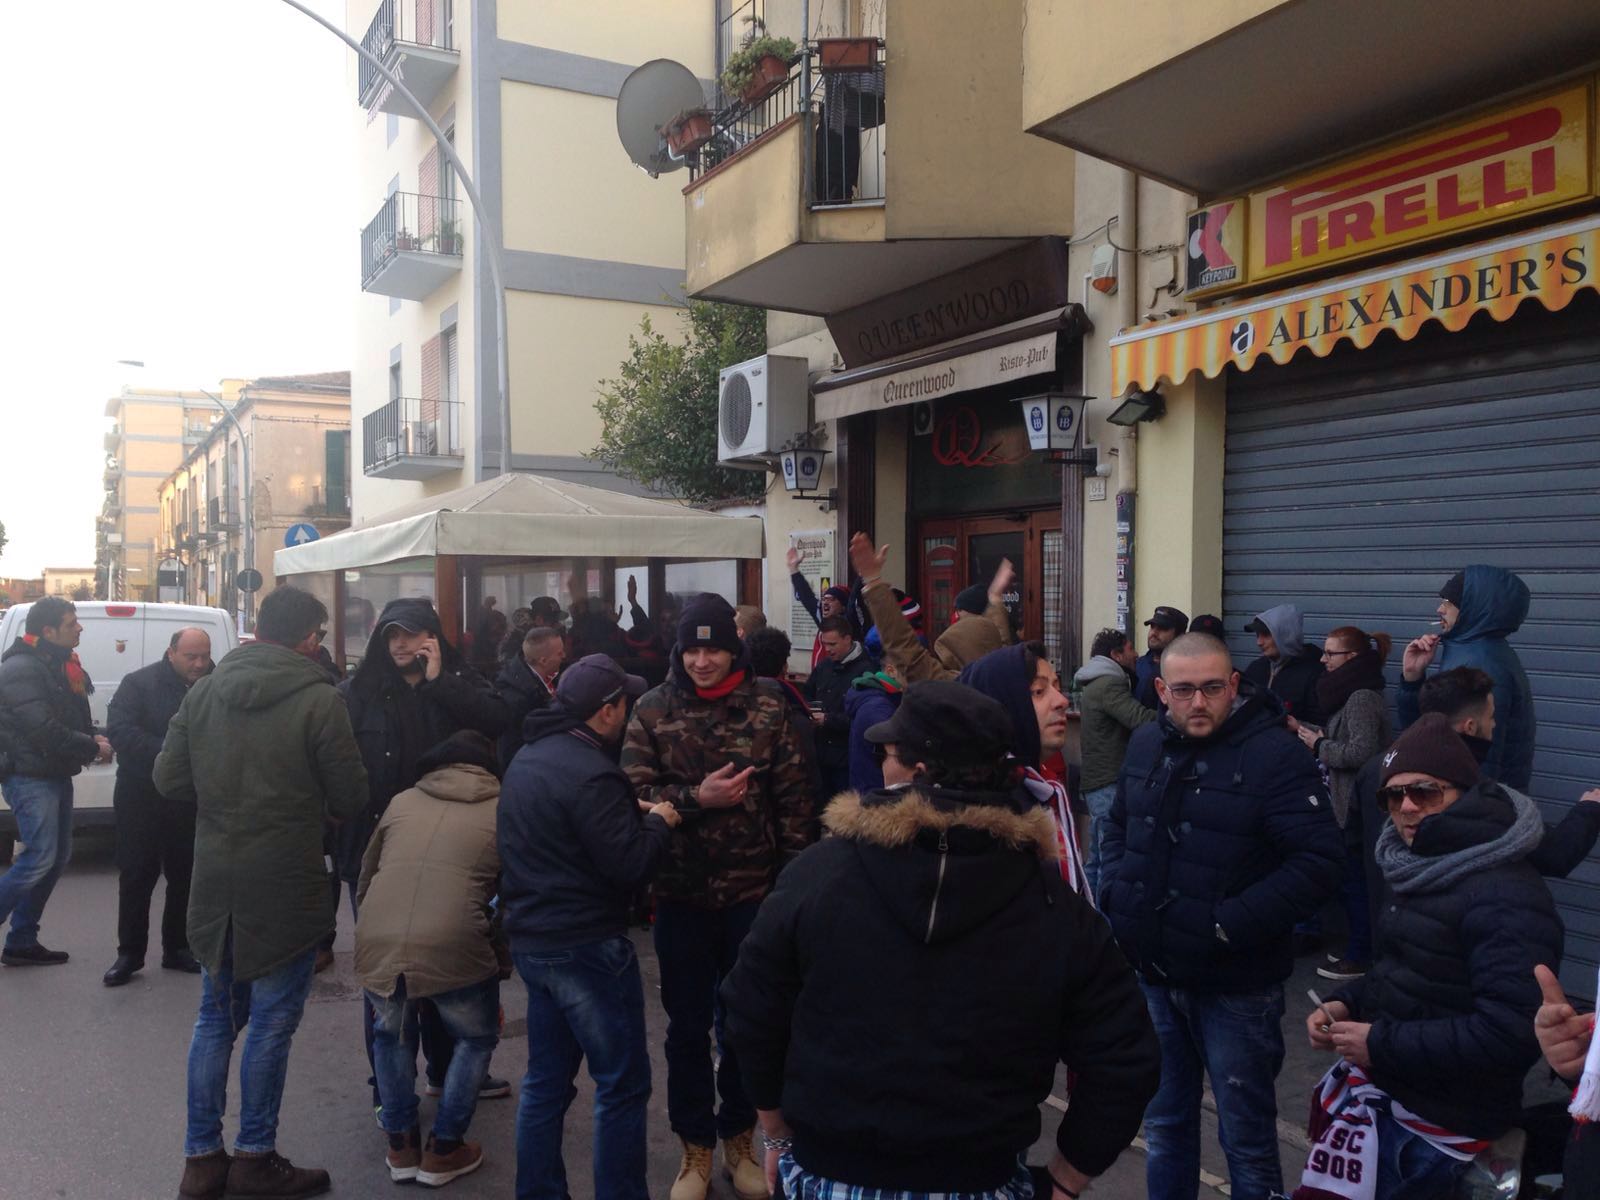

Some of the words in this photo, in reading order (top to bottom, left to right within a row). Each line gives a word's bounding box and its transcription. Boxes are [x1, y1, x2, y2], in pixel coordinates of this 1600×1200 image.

[1265, 107, 1562, 267] PIRELLI
[857, 279, 1030, 355] QUEENWOOD
[1267, 246, 1588, 347] ALEXANDER'S
[883, 368, 955, 404] Queenwood
[1304, 1149, 1363, 1184] 908
